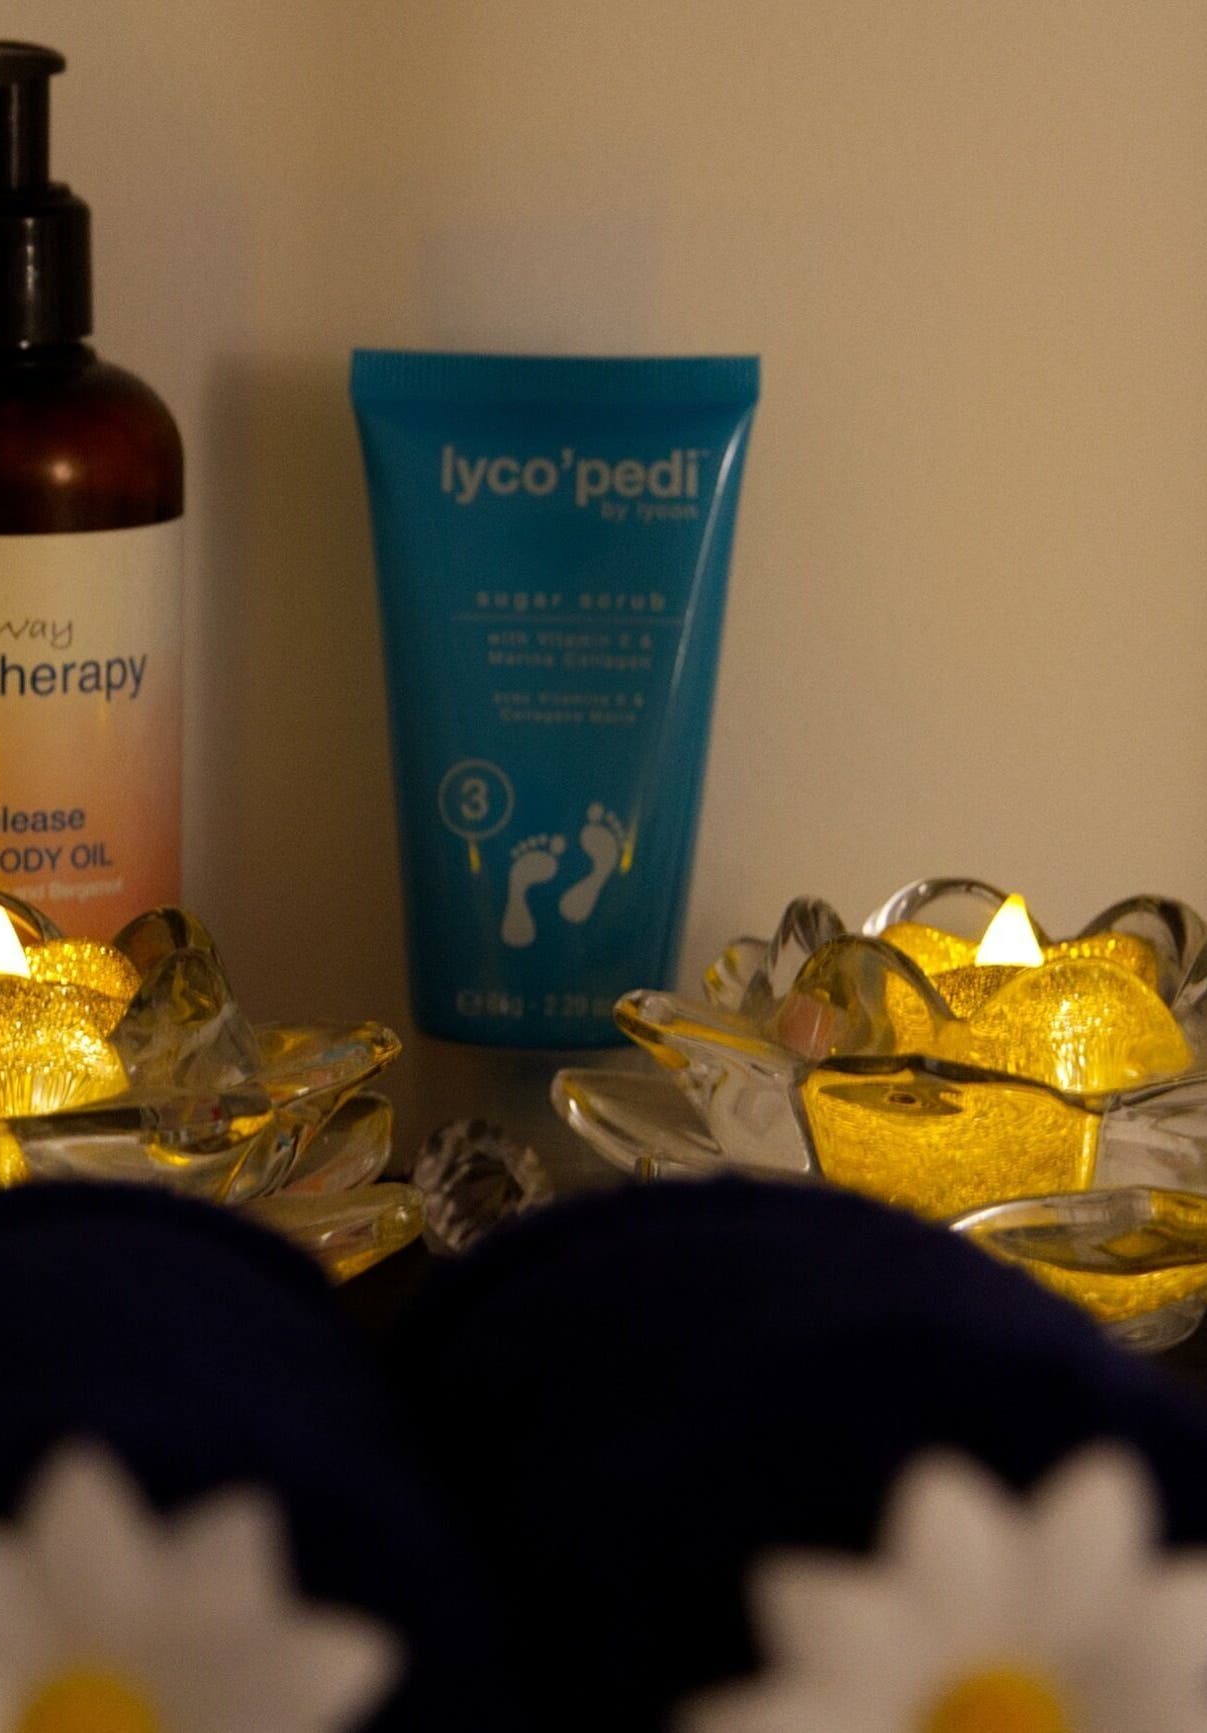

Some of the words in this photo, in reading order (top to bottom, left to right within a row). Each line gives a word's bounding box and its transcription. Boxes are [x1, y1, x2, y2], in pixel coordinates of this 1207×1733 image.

[476, 591, 563, 611] sugar
[577, 591, 668, 612] scrub
[461, 778, 489, 820] 3
[70, 843, 114, 870] OIL
